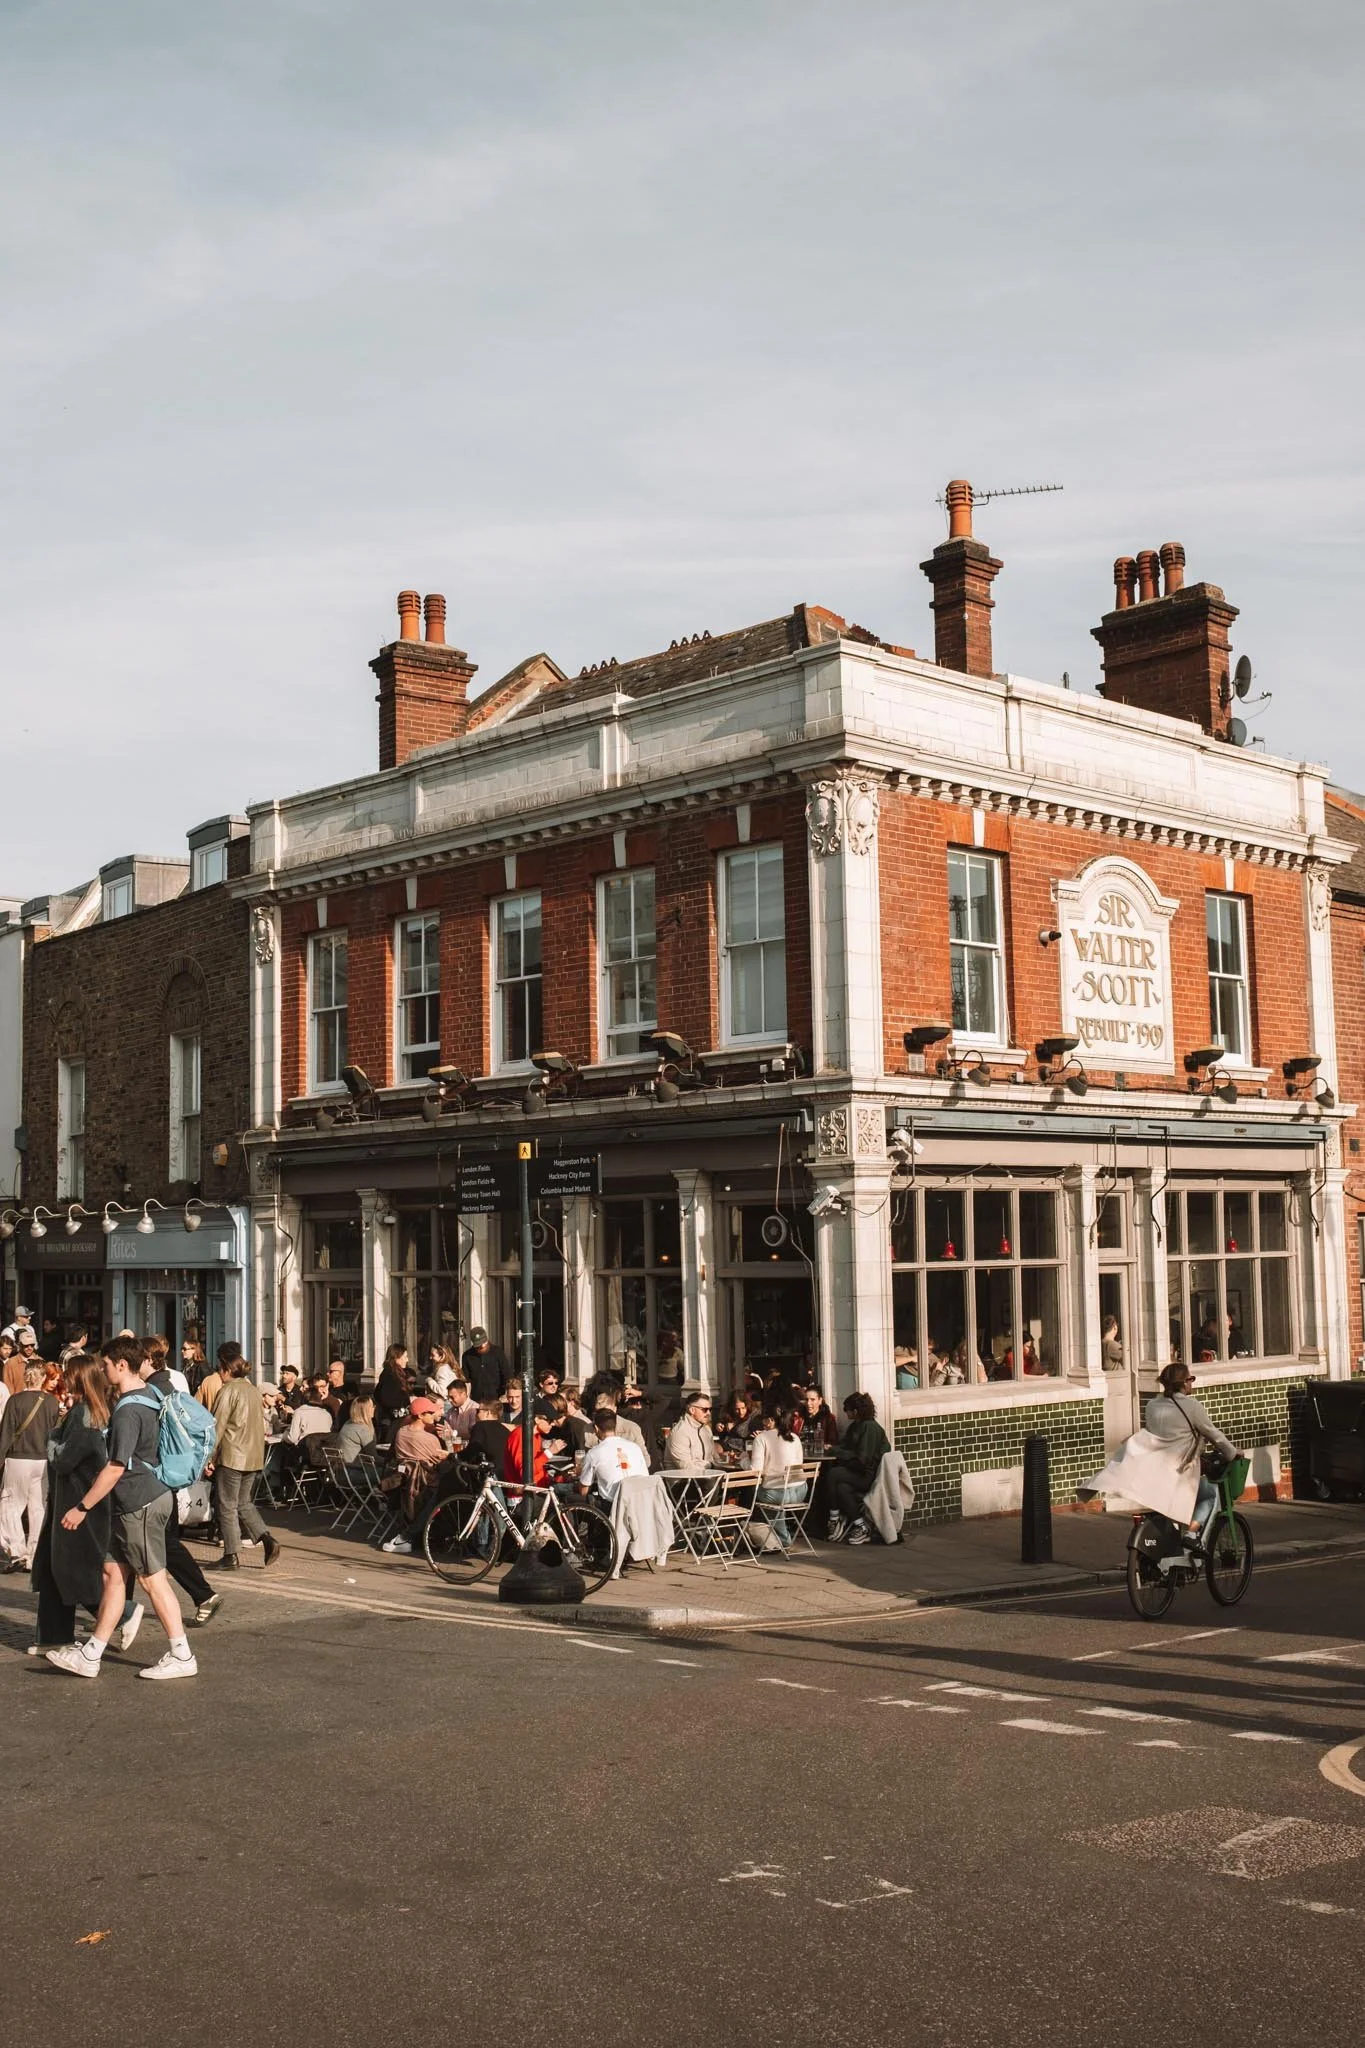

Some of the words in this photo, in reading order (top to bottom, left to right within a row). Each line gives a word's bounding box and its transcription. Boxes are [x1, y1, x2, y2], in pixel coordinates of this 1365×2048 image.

[1094, 894, 1136, 928] SIR
[1070, 928, 1157, 971] WALTER
[1072, 971, 1161, 1008] SCOTT
[1075, 1016, 1131, 1049] REBUILT
[1136, 1022, 1164, 1051] 1909
[553, 1159, 580, 1167] Haggerston
[462, 1166, 478, 1174] London
[478, 1164, 491, 1172] Fields
[549, 1172, 568, 1181] Hackney
[568, 1171, 578, 1181] City
[462, 1179, 478, 1187] London
[540, 1187, 562, 1195] Columbia
[574, 1185, 591, 1193] Market
[462, 1192, 479, 1200] Hackney
[462, 1205, 480, 1213] Hackney
[110, 1236, 137, 1260] Rites
[196, 1499, 203, 1507] 4
[494, 1501, 521, 1538] CUBE
